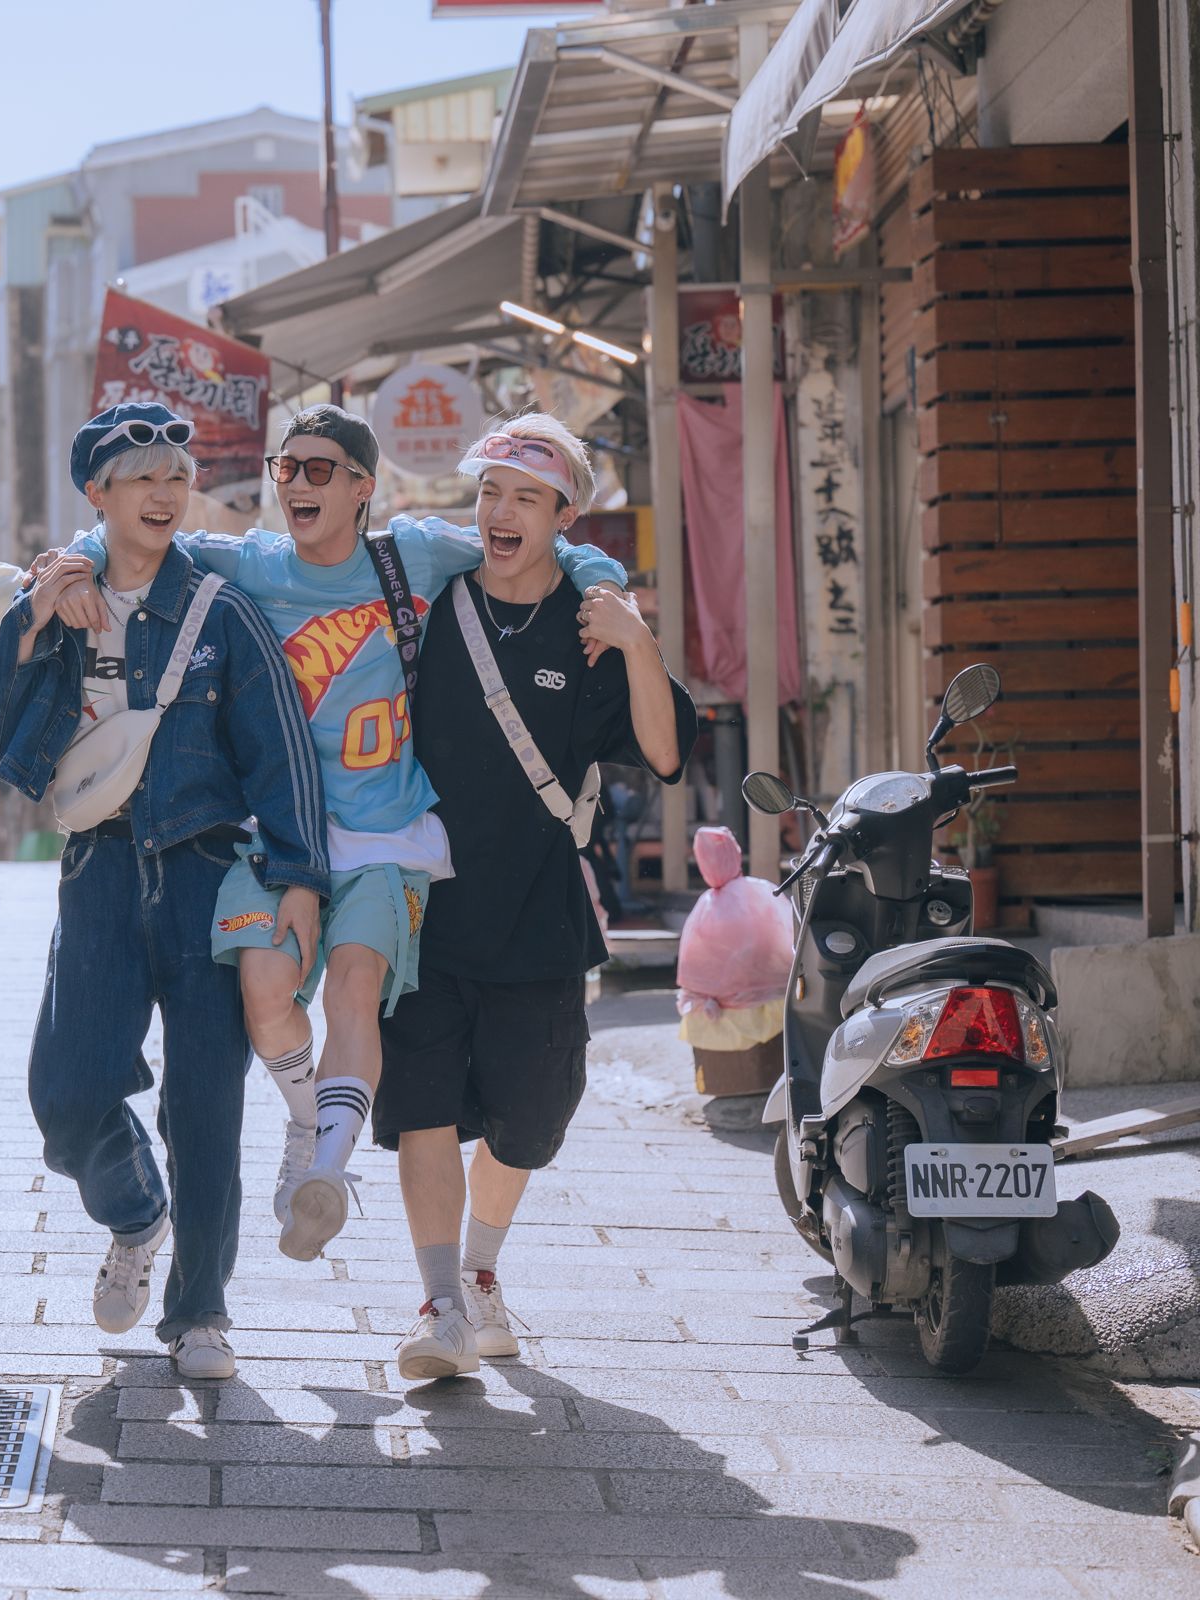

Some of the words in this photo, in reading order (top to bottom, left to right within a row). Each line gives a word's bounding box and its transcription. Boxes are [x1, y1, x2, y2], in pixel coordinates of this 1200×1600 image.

[376, 541, 405, 603] SUMMER
[172, 600, 208, 665] OZONE
[286, 602, 393, 705] WHEEL
[486, 677, 510, 718] SUER
[911, 1163, 1048, 1199] NNR-2207
